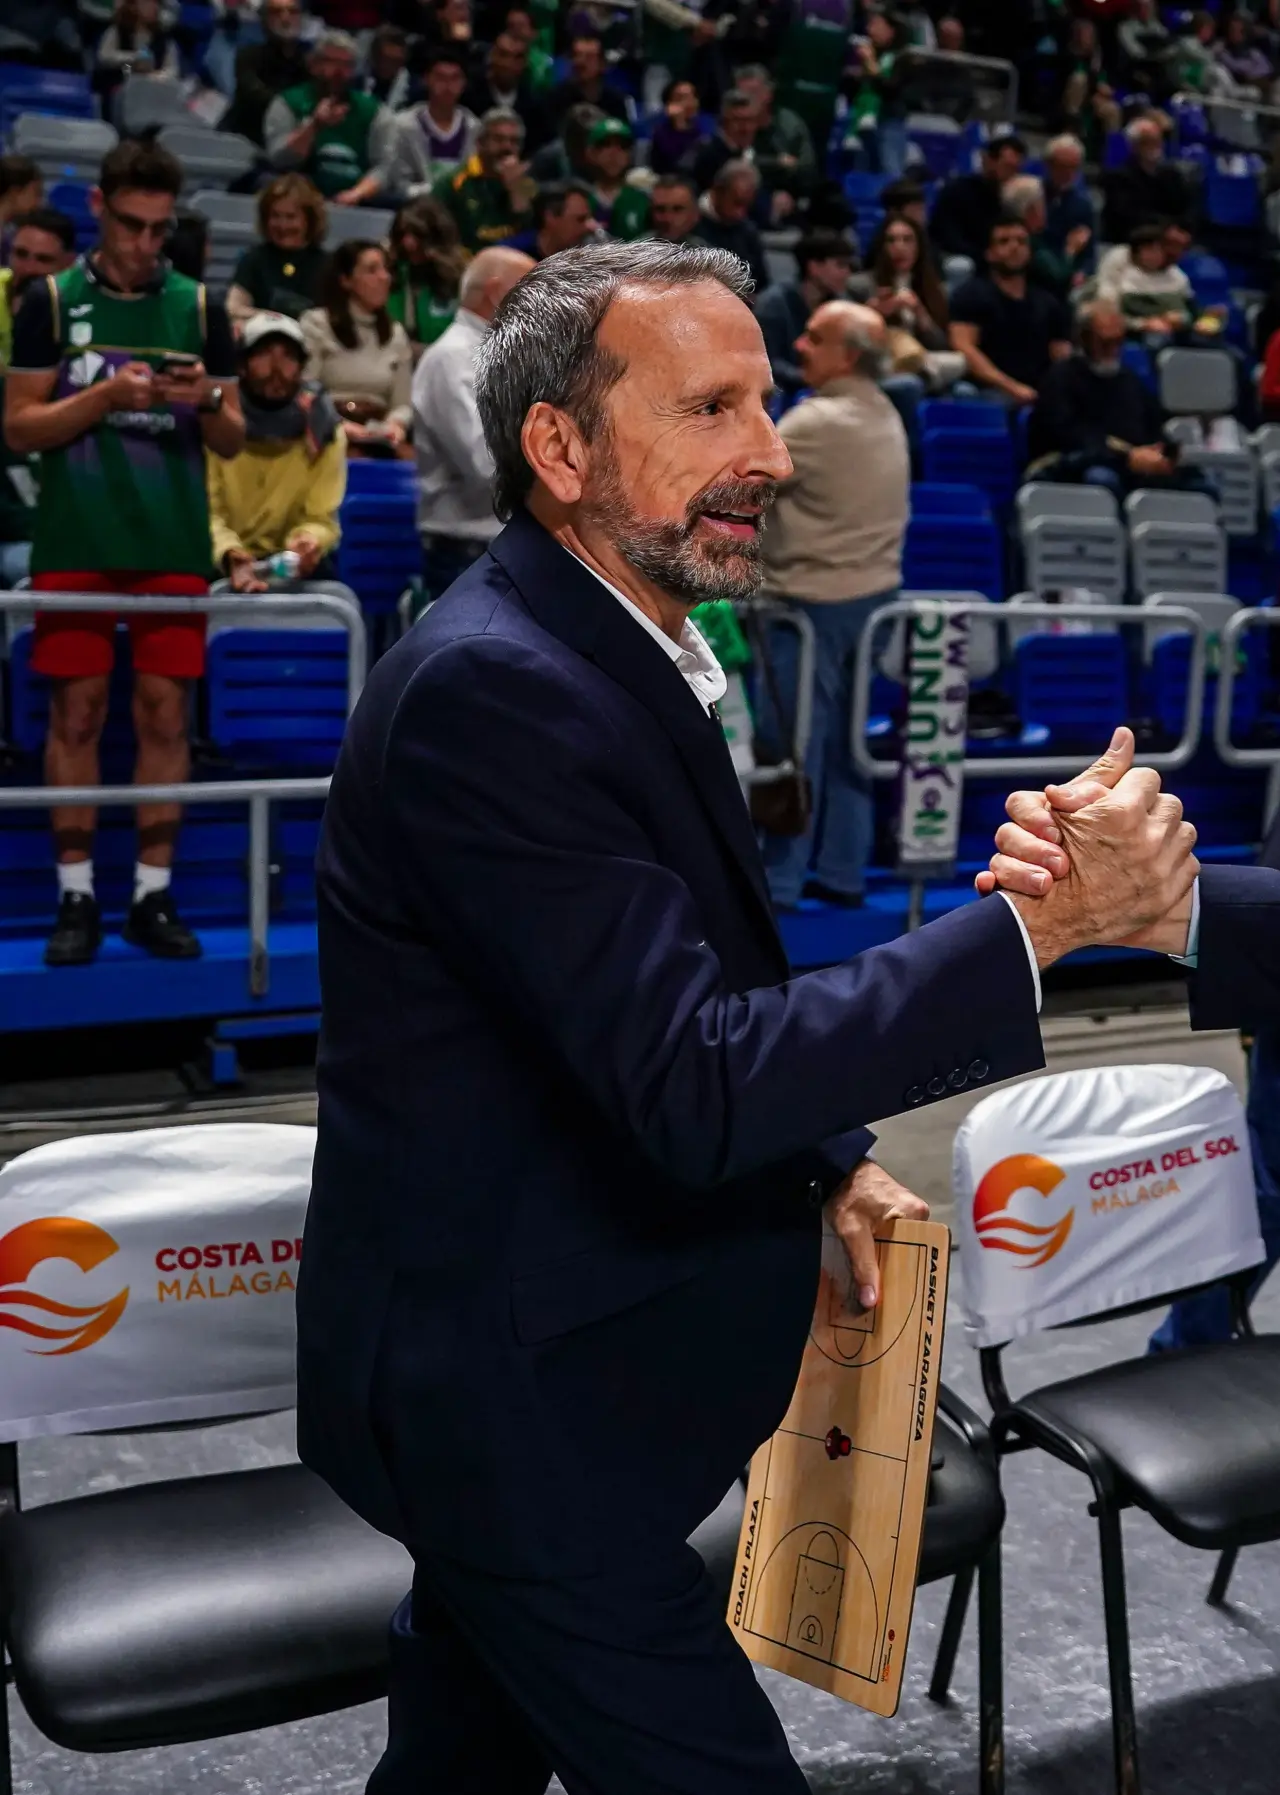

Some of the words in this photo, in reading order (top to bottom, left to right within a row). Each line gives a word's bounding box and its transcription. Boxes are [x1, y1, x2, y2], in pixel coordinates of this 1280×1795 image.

[1089, 1159, 1157, 1190] COSTA
[1160, 1147, 1202, 1172] DEL
[1204, 1134, 1240, 1160] SOL
[155, 1241, 264, 1272] COSTA
[157, 1269, 295, 1303] MÁLAGA
[926, 1246, 939, 1326] BASKET
[914, 1333, 932, 1442] ZARAGOZA
[733, 1565, 749, 1627] COACH
[745, 1499, 760, 1560] PLAZA
